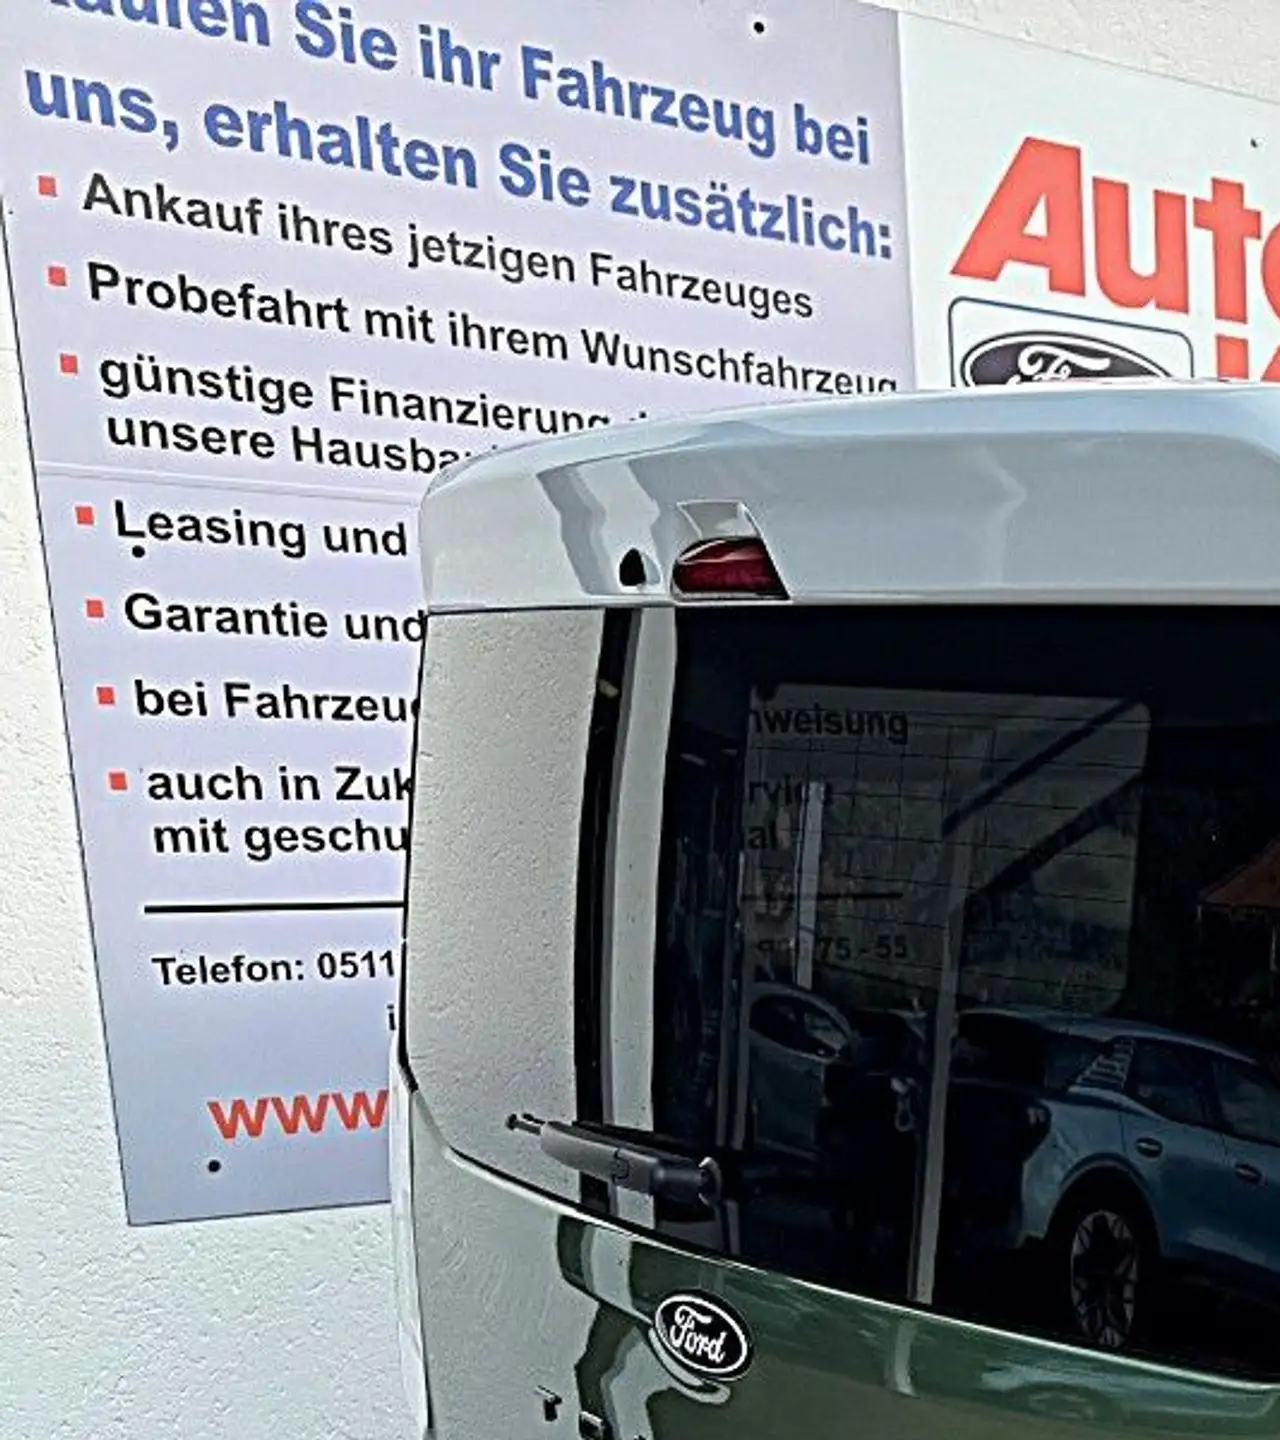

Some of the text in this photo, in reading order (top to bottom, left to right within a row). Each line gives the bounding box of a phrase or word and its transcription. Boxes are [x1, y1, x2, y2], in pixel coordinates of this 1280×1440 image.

[295, 0, 398, 72] Sie
[419, 24, 501, 91] ihr
[521, 45, 776, 160] Fahrzeug
[794, 103, 870, 165] bei
[25, 69, 893, 260] uns, erhalten Sie zusätzlich:
[83, 173, 814, 320] Ankauf ihres jetzigen Fahrzeuges
[88, 261, 350, 333] Probefahrt
[365, 305, 436, 343] mit
[448, 311, 569, 361] ihrem
[100, 354, 314, 415] günstige
[108, 417, 275, 459] unsere
[114, 499, 408, 560] Leasing und
[124, 592, 426, 642] Garantie und
[134, 679, 208, 717] bei
[148, 765, 263, 801] auch
[279, 765, 321, 801] in
[153, 818, 408, 862] mit geschu
[152, 950, 396, 986] Telefon: 0511
[669, 1303, 728, 1365] Ford
